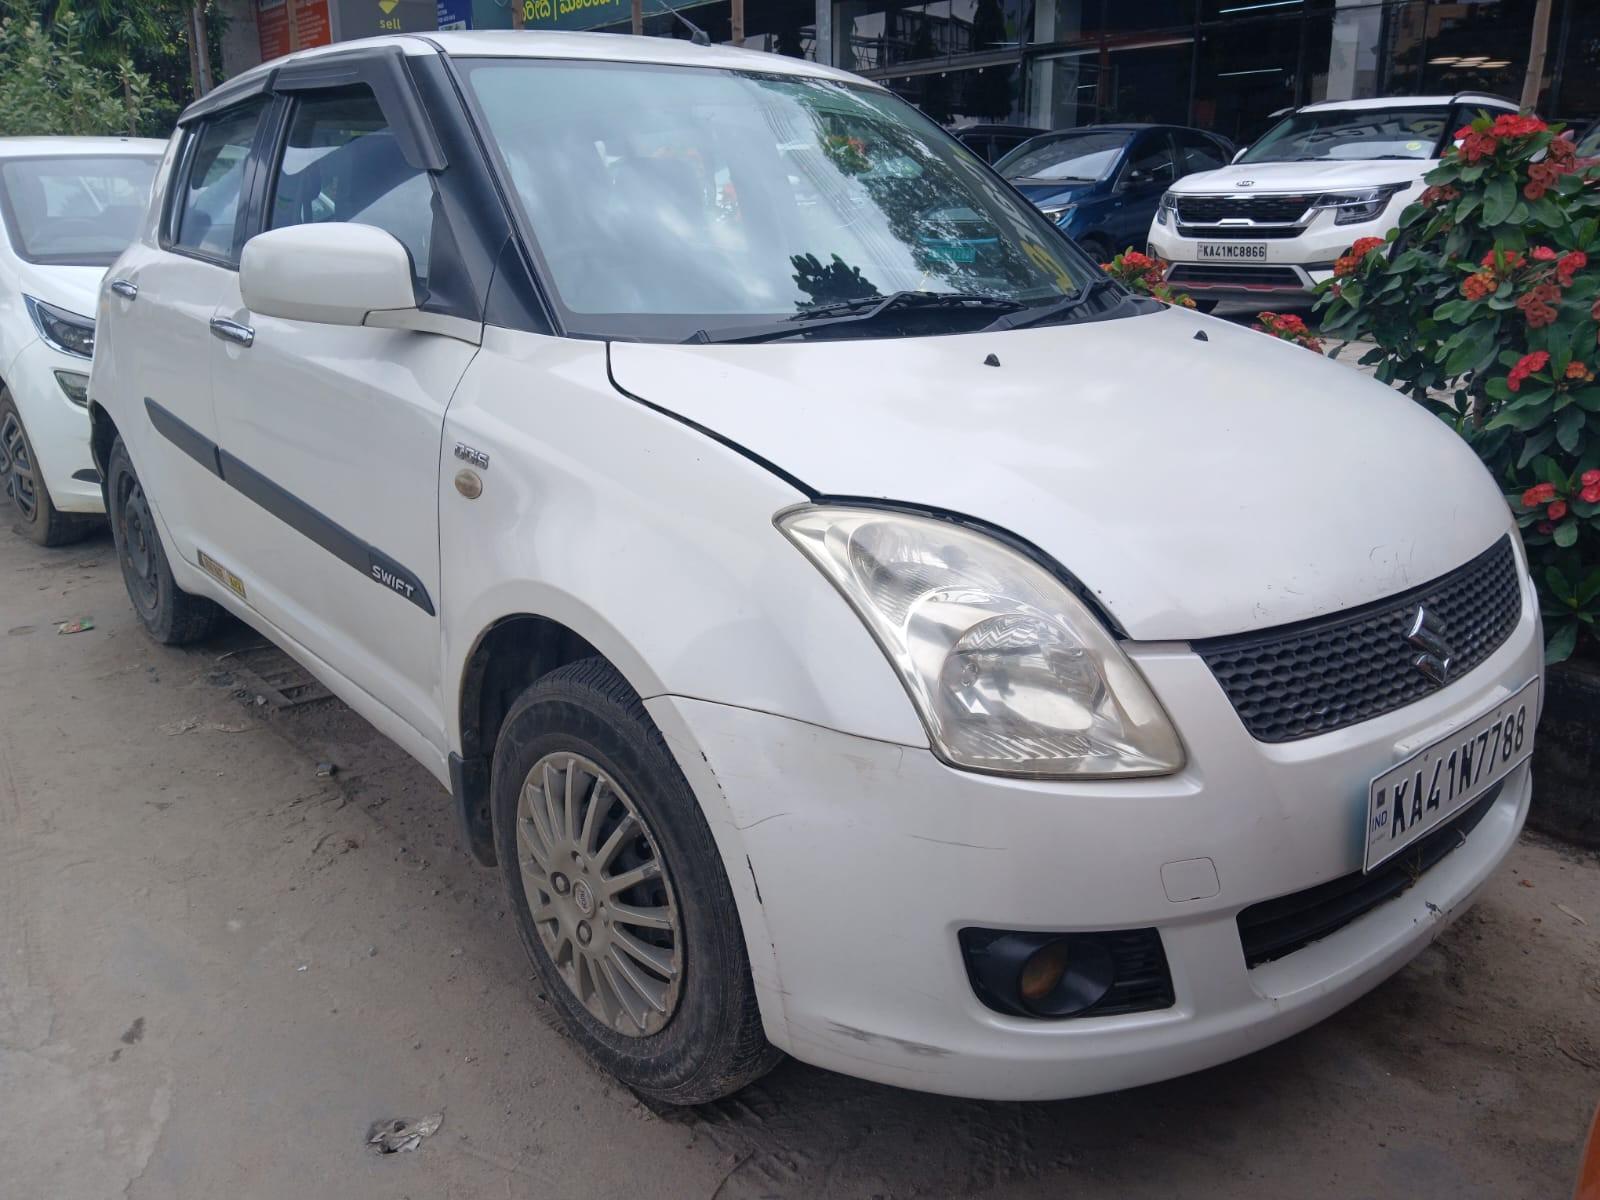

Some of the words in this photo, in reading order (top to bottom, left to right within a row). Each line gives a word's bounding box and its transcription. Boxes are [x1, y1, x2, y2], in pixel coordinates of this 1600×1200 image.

[380, 18, 401, 30] sell
[372, 565, 414, 598] SWIFT
[1391, 704, 1526, 839] KA41N7788
[1371, 810, 1388, 832] IND
